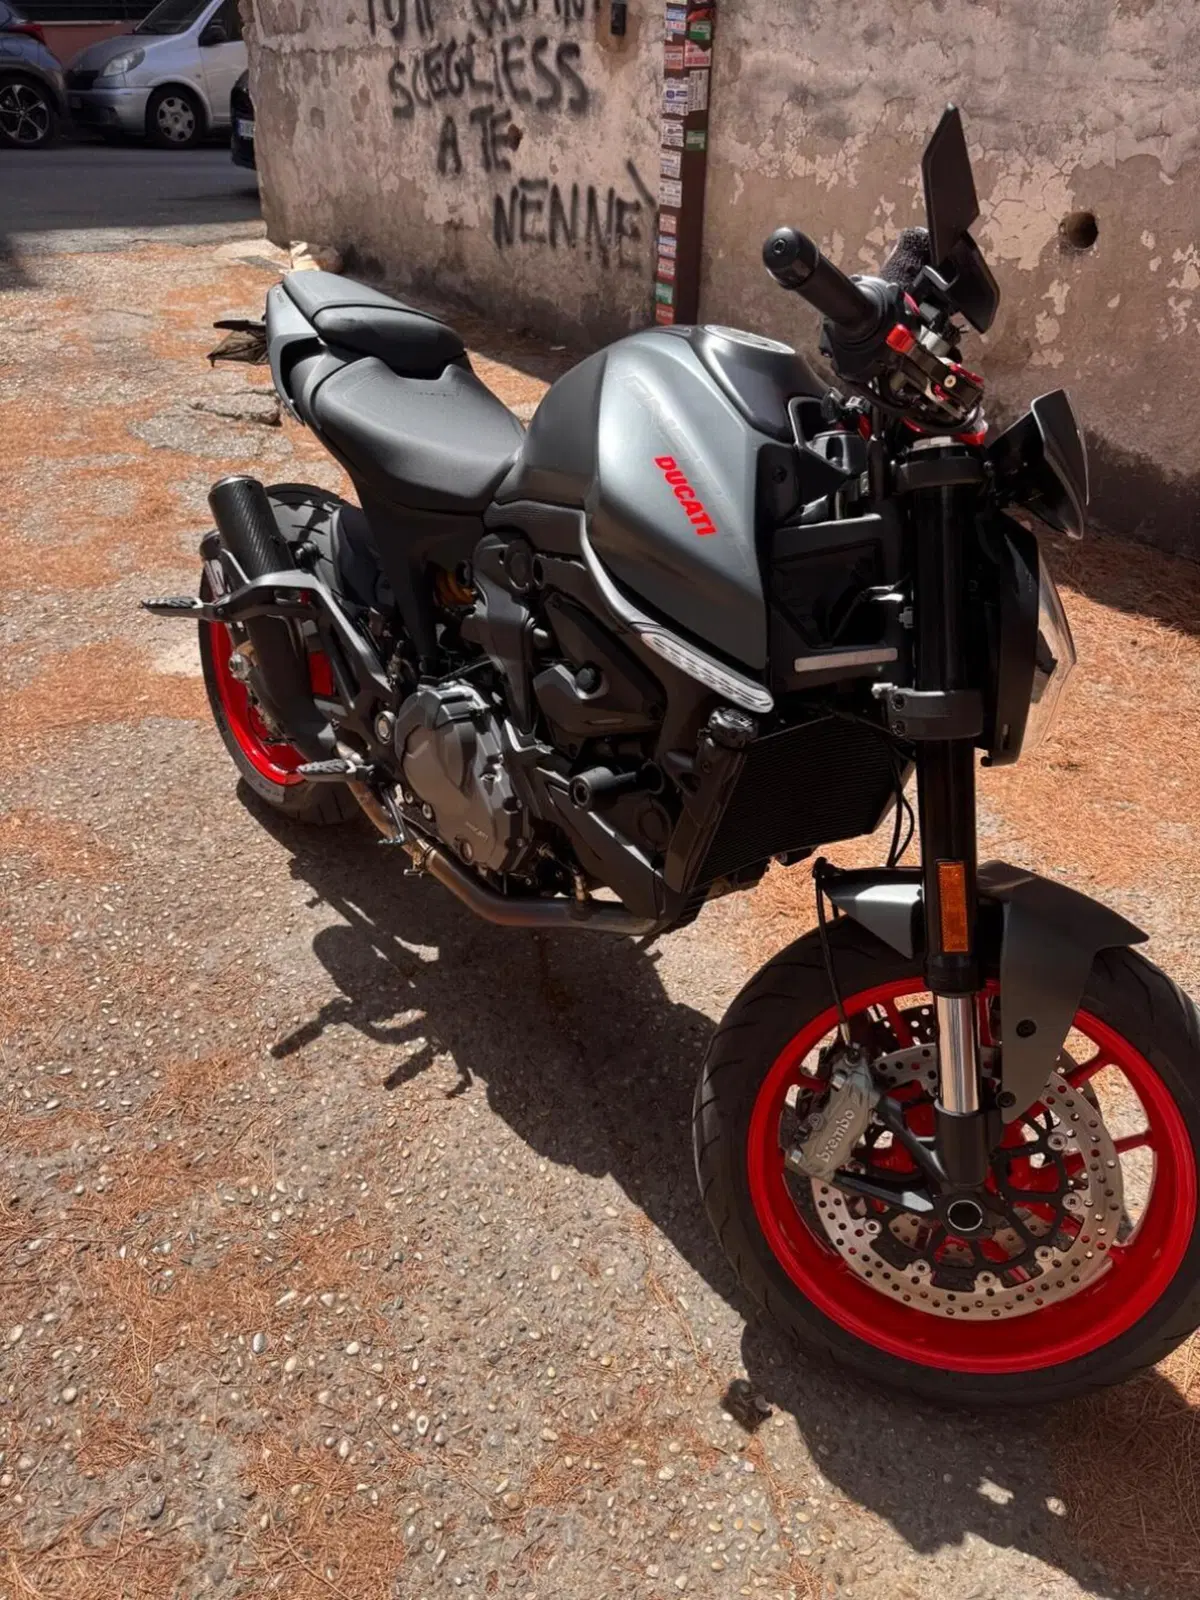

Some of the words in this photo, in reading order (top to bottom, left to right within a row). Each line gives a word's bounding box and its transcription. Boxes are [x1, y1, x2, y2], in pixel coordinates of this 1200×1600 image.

[437, 115, 462, 175] A
[469, 104, 513, 173] TE
[653, 456, 717, 536] DUCATI
[815, 1109, 856, 1163] brembo
